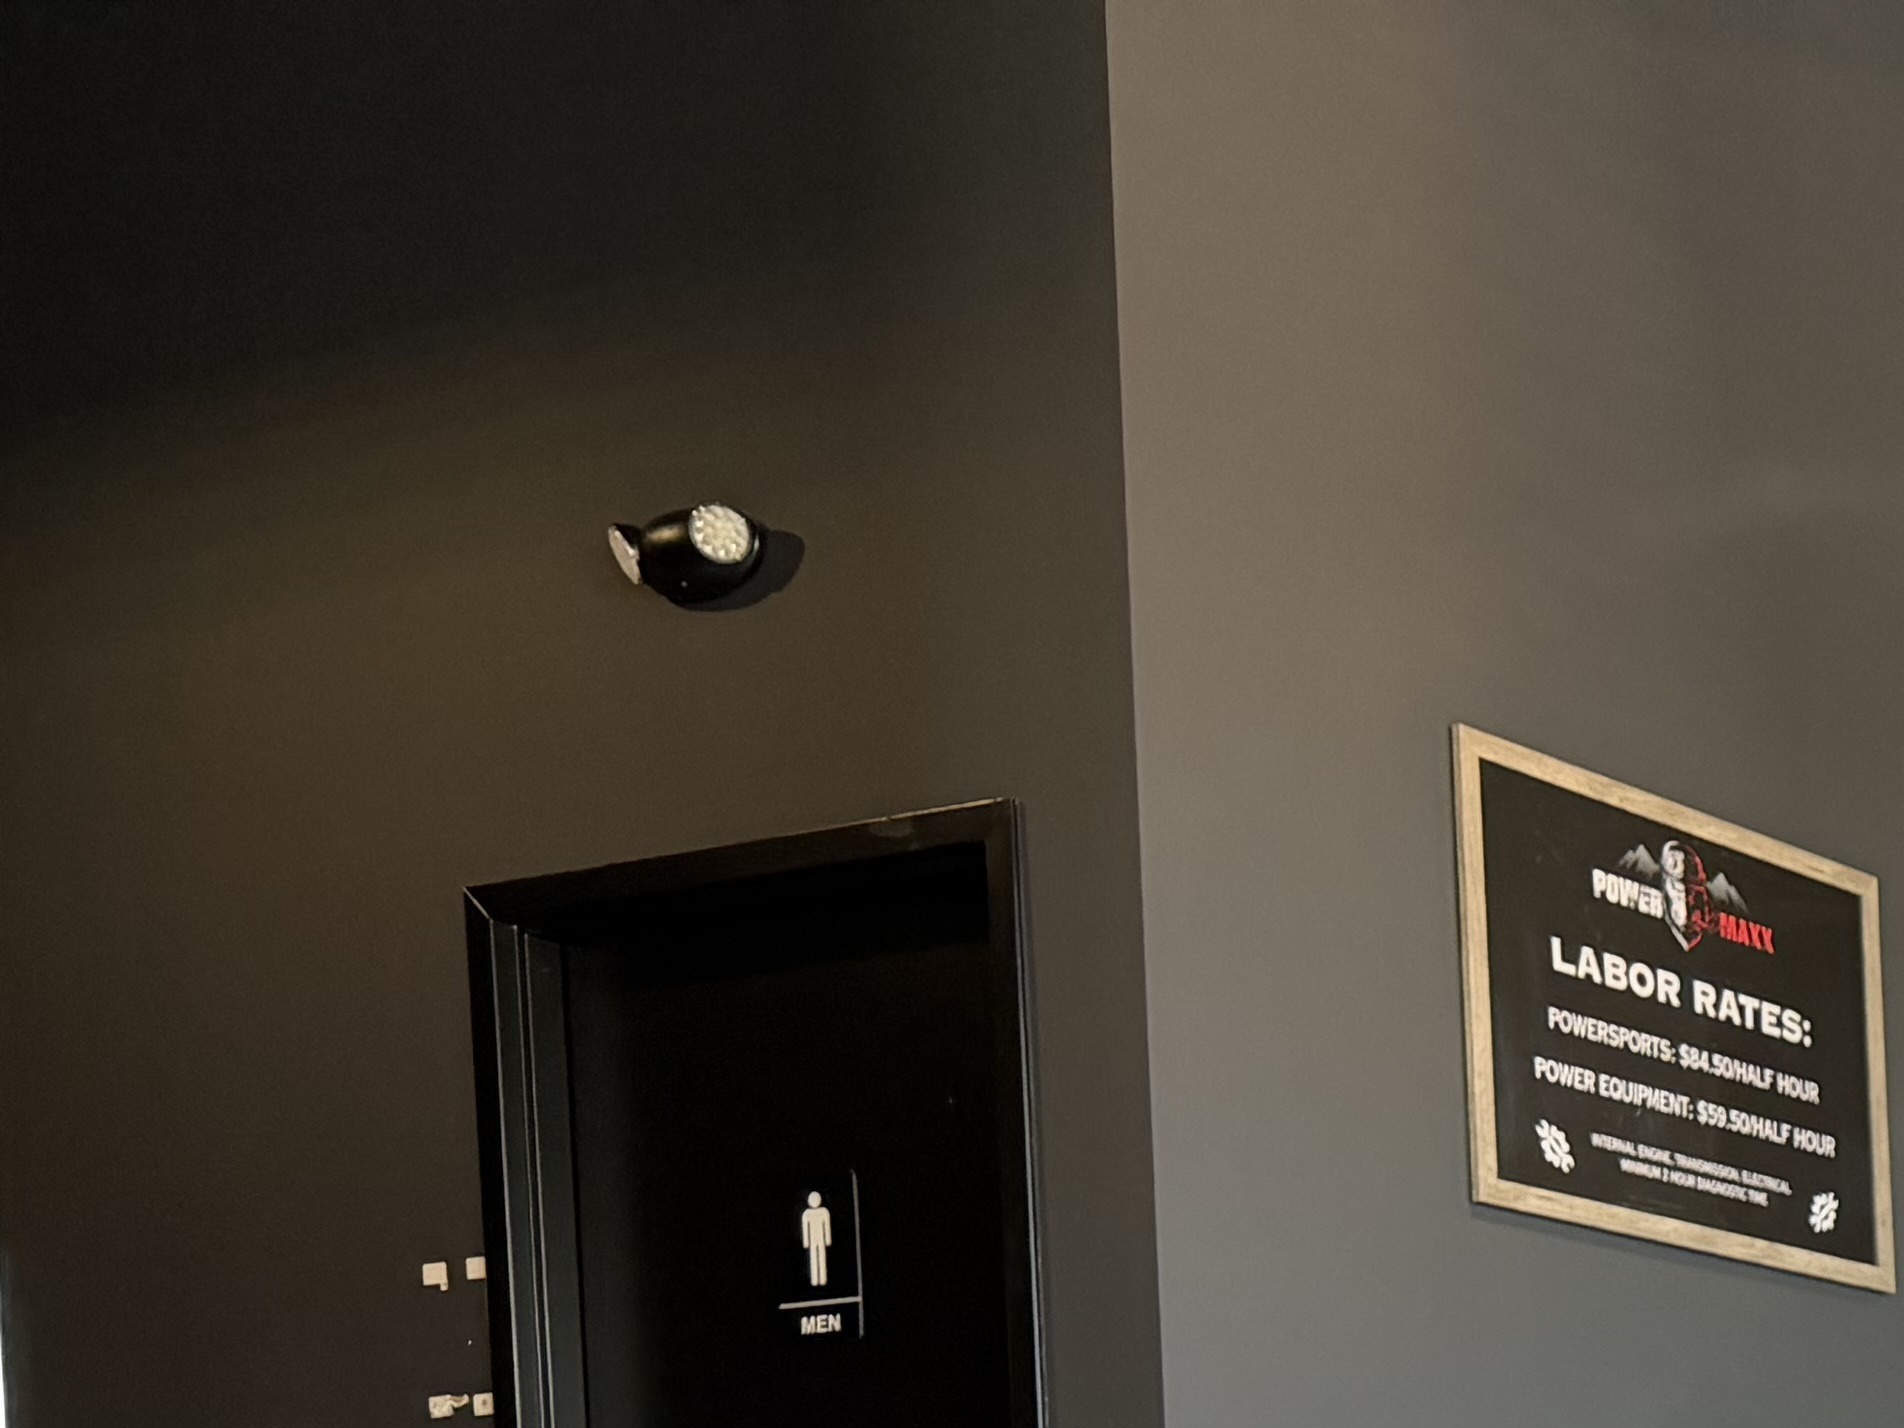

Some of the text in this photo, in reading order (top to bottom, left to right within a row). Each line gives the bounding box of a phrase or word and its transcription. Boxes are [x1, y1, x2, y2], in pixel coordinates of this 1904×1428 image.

[1592, 868, 1664, 919] POWER
[1719, 912, 1775, 955] MAXX
[1550, 935, 1812, 1048] LABOR RATES:
[1547, 1006, 1820, 1105] POWERSPORTS: $84.50/HALF HOUR
[1533, 1055, 1836, 1159] POWER EQUIPMENT: $59.50/HALF HOUR
[801, 1314, 841, 1334] MEN
